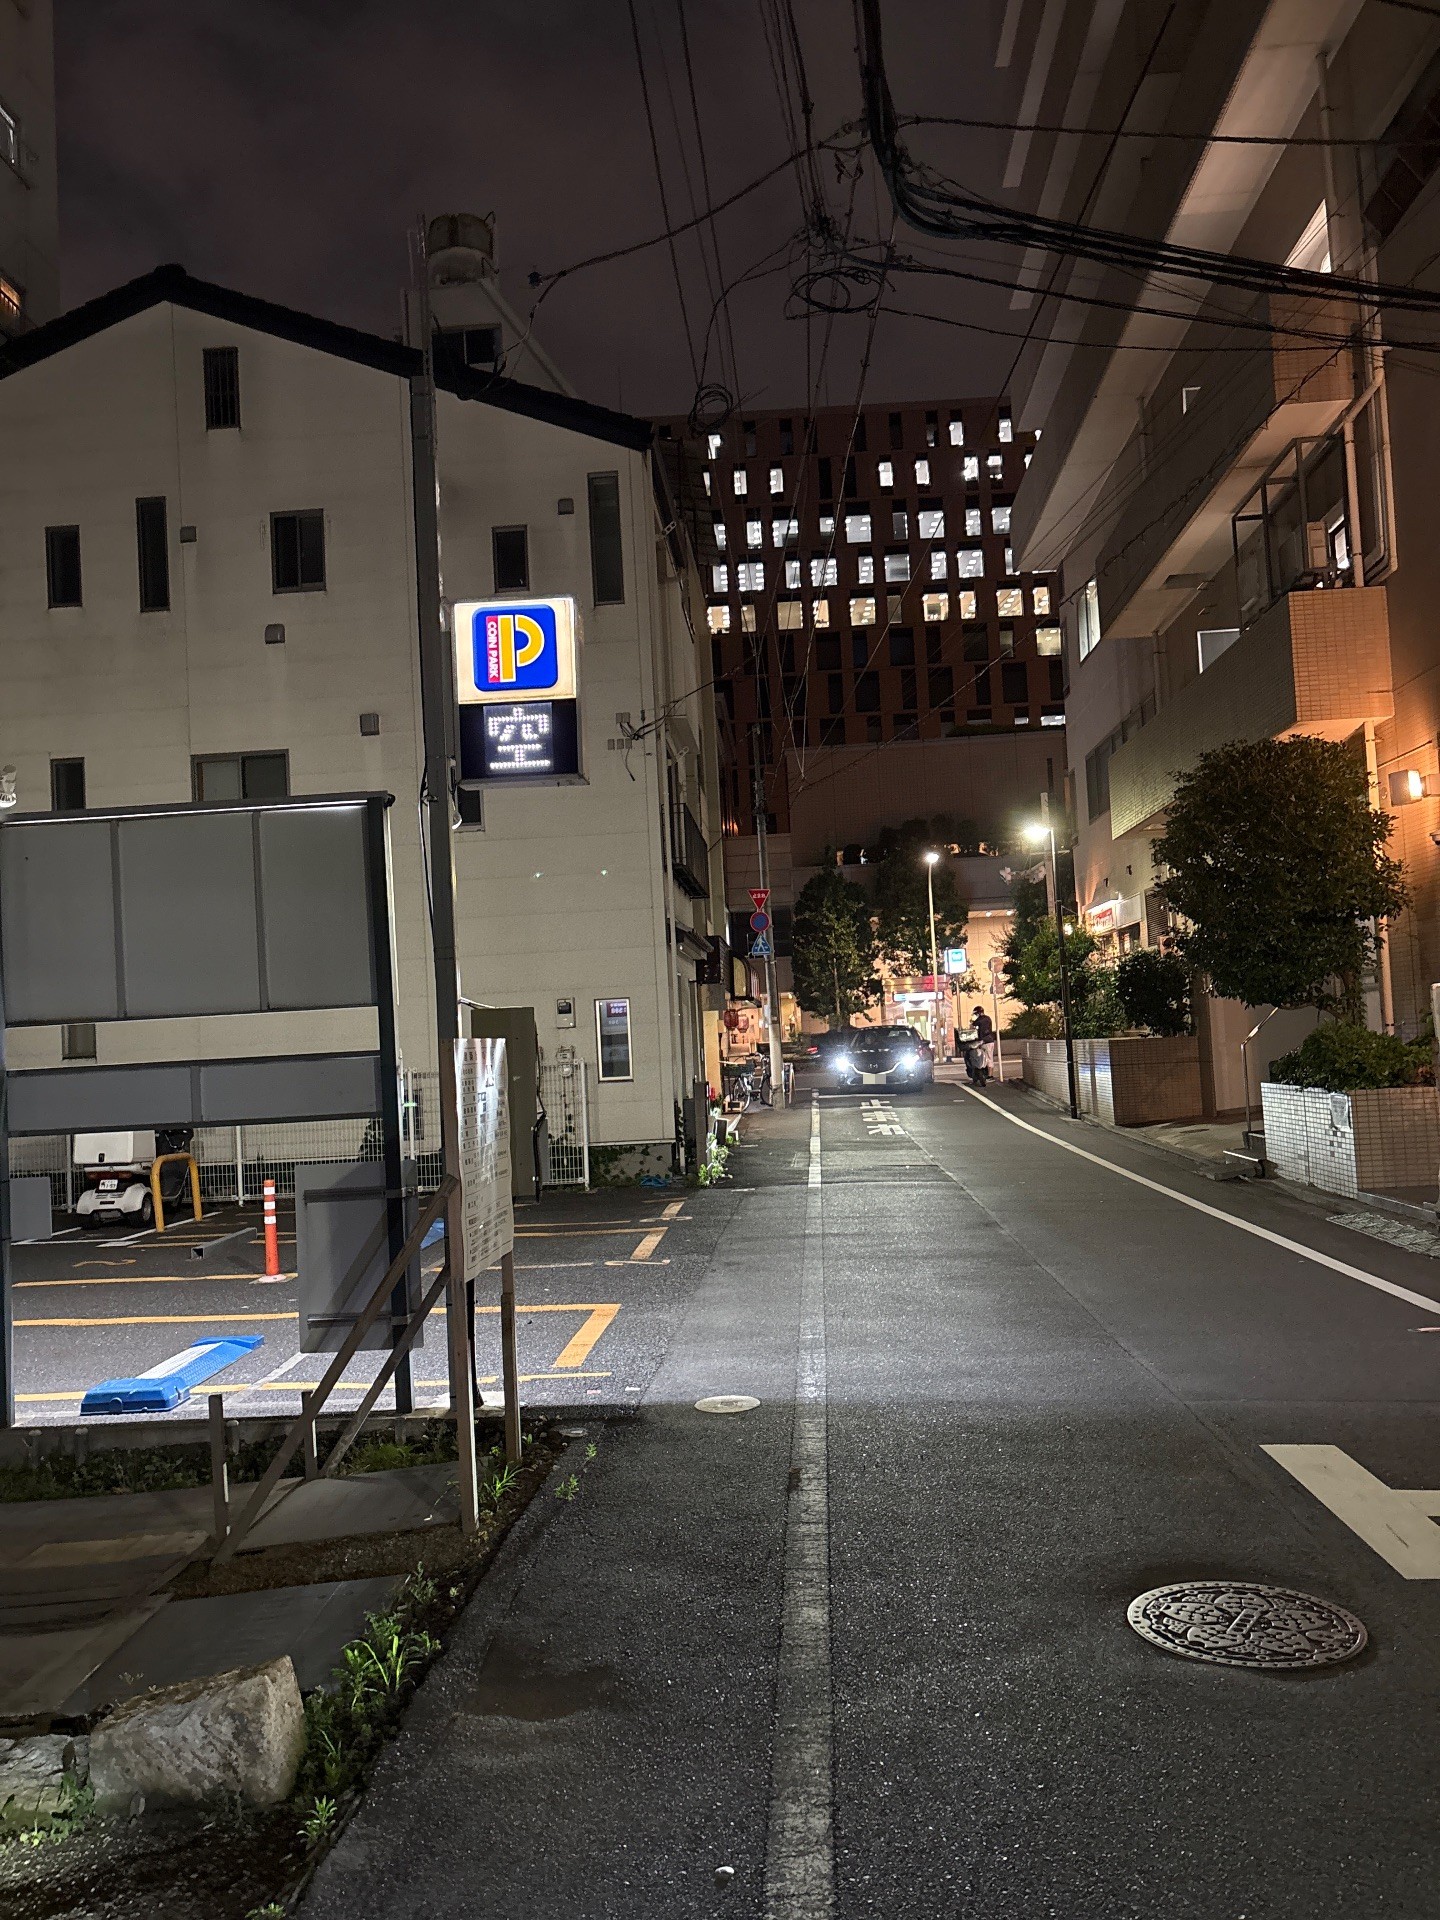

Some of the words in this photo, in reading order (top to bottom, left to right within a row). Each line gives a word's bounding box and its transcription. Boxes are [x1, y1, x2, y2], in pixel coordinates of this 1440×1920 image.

[487, 621, 498, 648] COIN
[489, 649, 500, 678] PARK
[488, 706, 551, 770] 空
